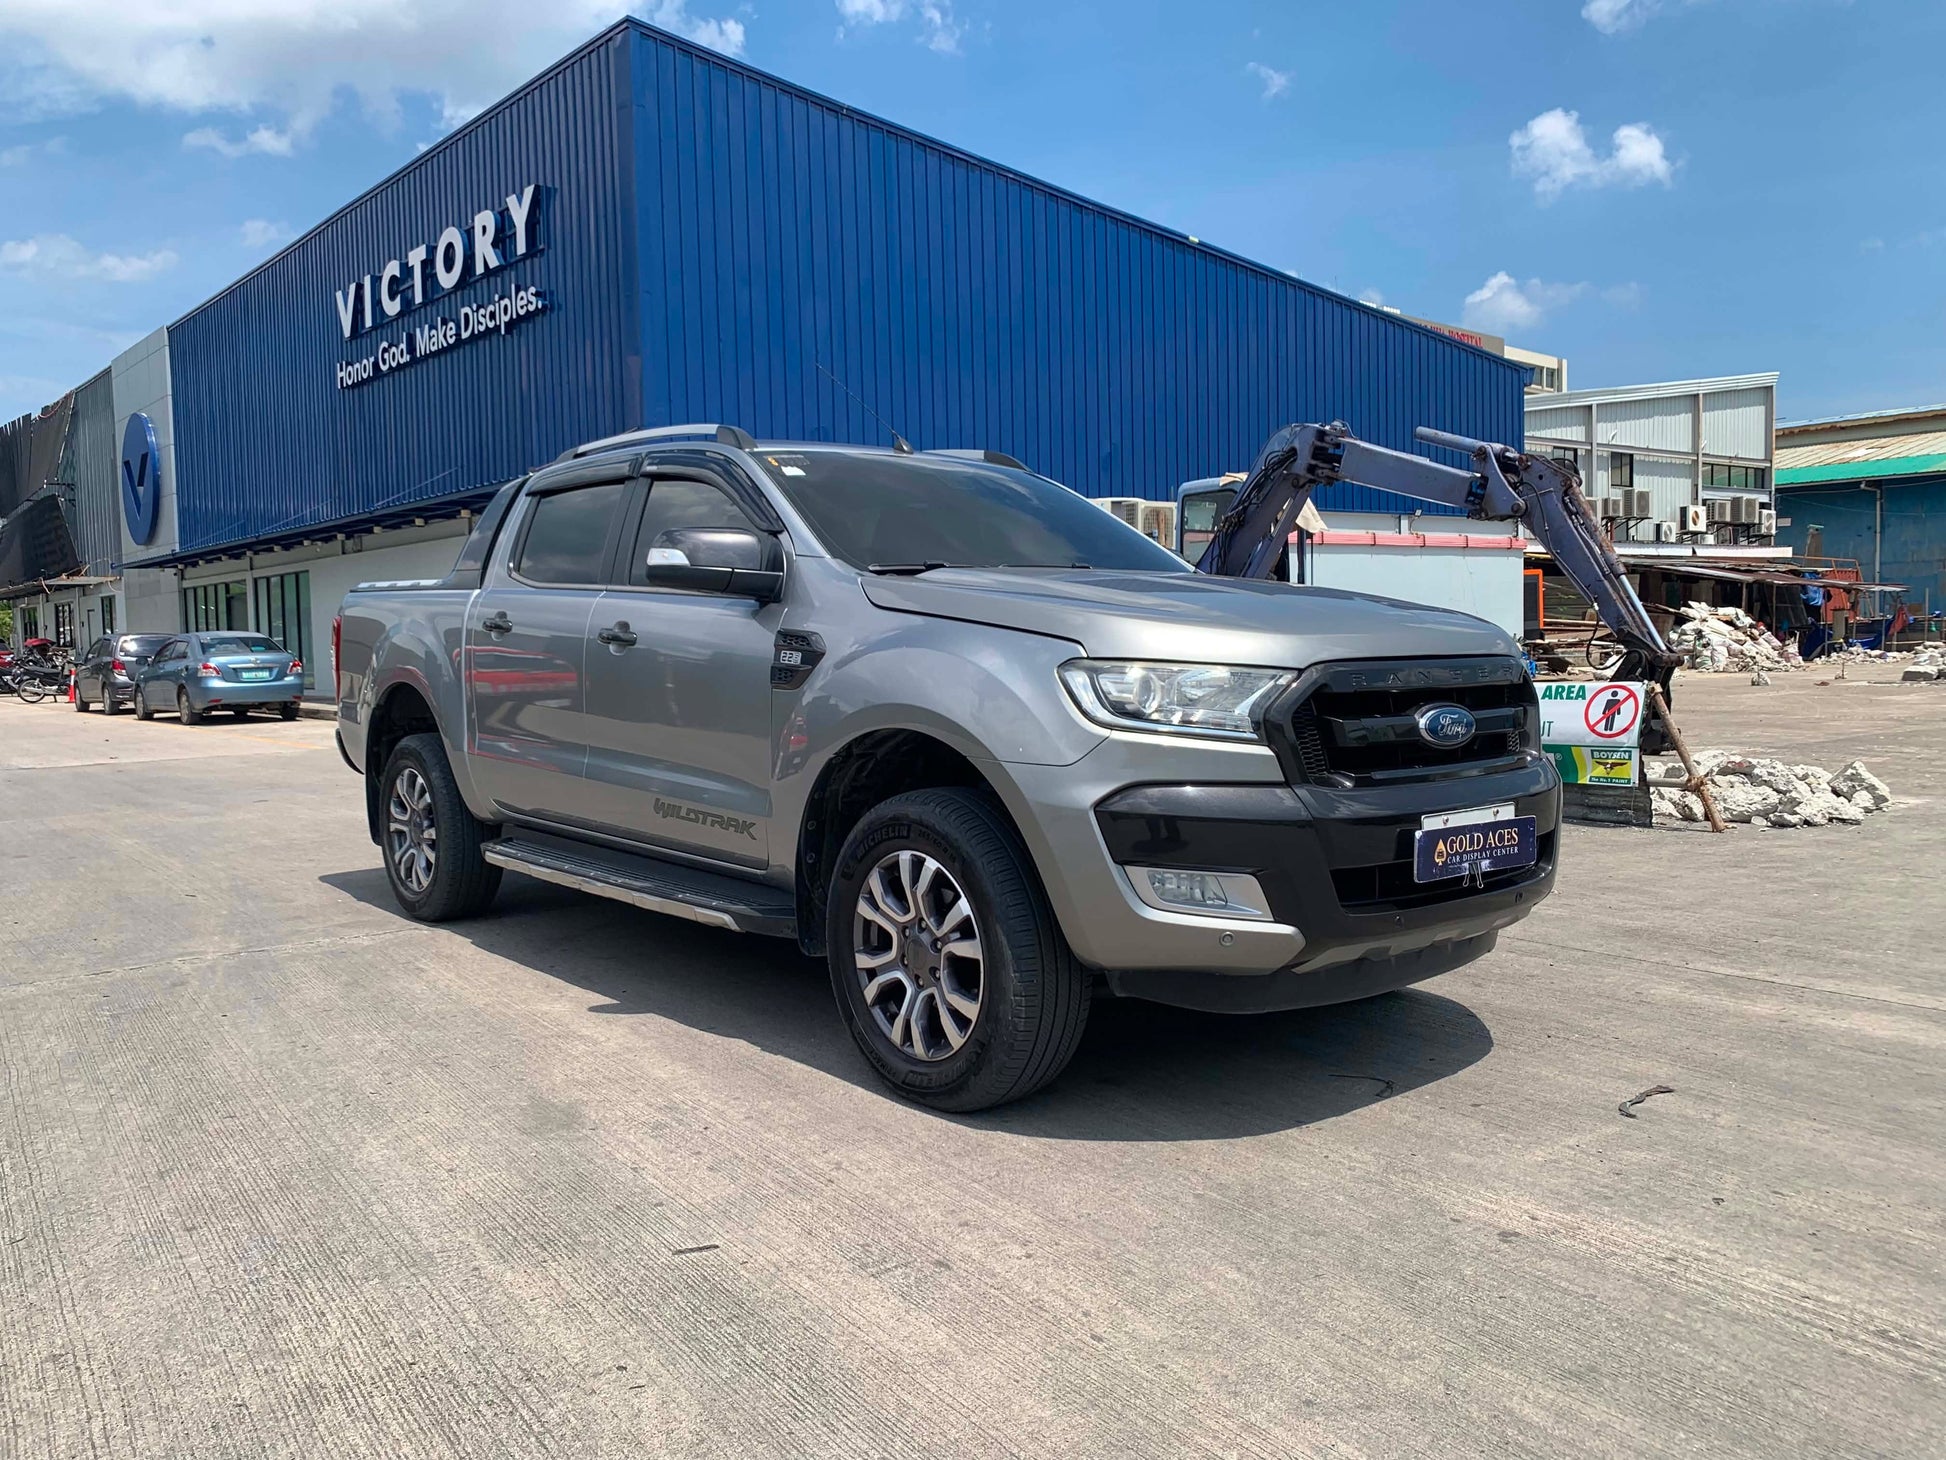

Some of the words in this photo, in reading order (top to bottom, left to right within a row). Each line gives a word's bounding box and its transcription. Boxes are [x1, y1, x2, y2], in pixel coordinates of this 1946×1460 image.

[336, 184, 535, 339] VICTORY
[337, 355, 374, 389] Honor
[378, 332, 410, 371] God.
[416, 317, 456, 358] Make
[460, 283, 542, 339] Disciples.
[1352, 666, 1515, 686] RANGER
[1541, 684, 1587, 700] AREA
[1438, 713, 1468, 737] Ford
[1593, 751, 1629, 759] BOYSEN
[653, 798, 757, 840] WILDTRAK
[1447, 832, 1484, 854] GOLD
[1486, 828, 1519, 848] ACES
[1447, 855, 1461, 864] CAR
[1462, 851, 1490, 862] DISPLAY
[1492, 846, 1519, 857] CENTER
